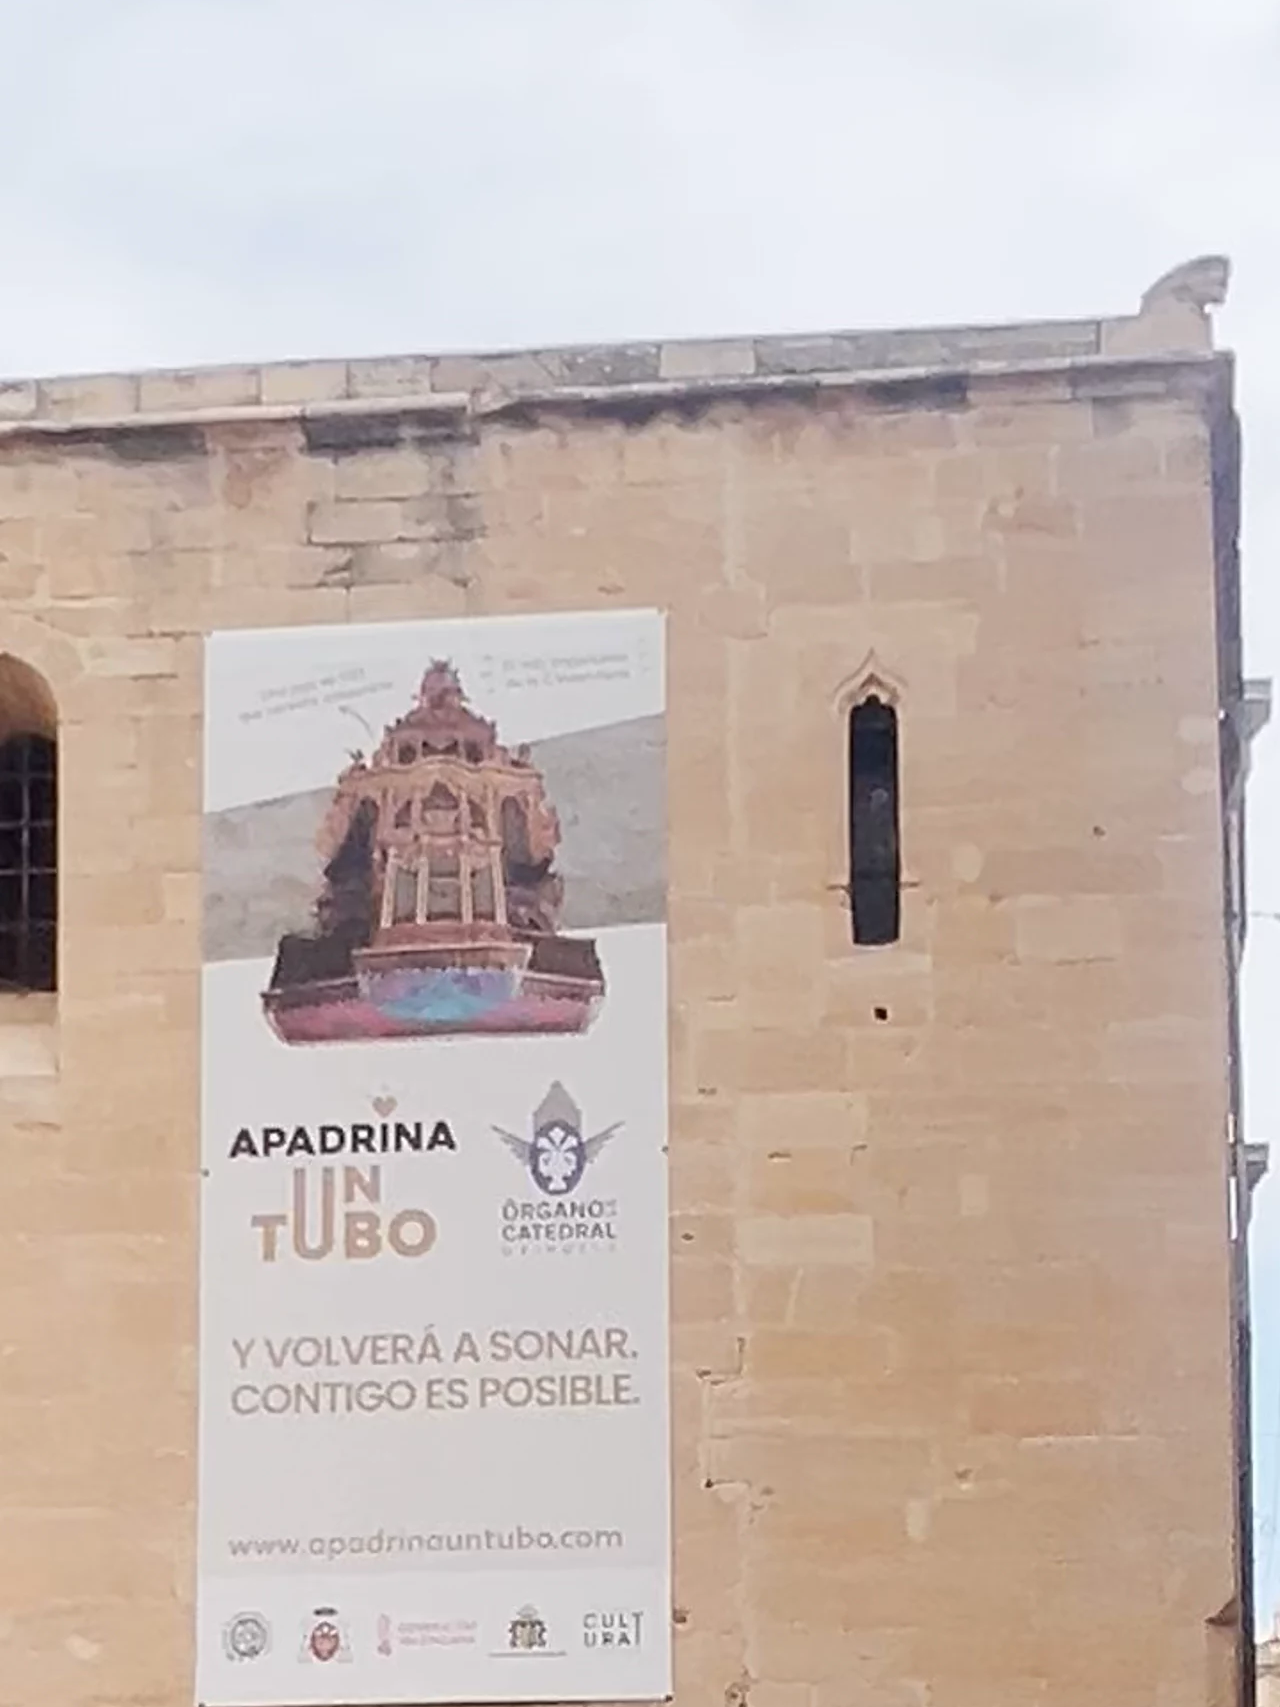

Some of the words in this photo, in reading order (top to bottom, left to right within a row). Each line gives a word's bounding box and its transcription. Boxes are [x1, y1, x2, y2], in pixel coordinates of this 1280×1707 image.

[228, 1120, 457, 1159] APADRINA
[251, 1166, 438, 1263] TUBO
[501, 1223, 617, 1242] CATEDRAL
[232, 1337, 256, 1369] Y
[265, 1324, 441, 1369] VOLVERÁ
[453, 1330, 480, 1364] A
[490, 1327, 639, 1362] SONAR.
[230, 1379, 417, 1416] CONTIGO
[426, 1377, 467, 1410] ES
[479, 1373, 641, 1410] POSIBLE.
[227, 1524, 624, 1561] www.apadrinauntubo.com
